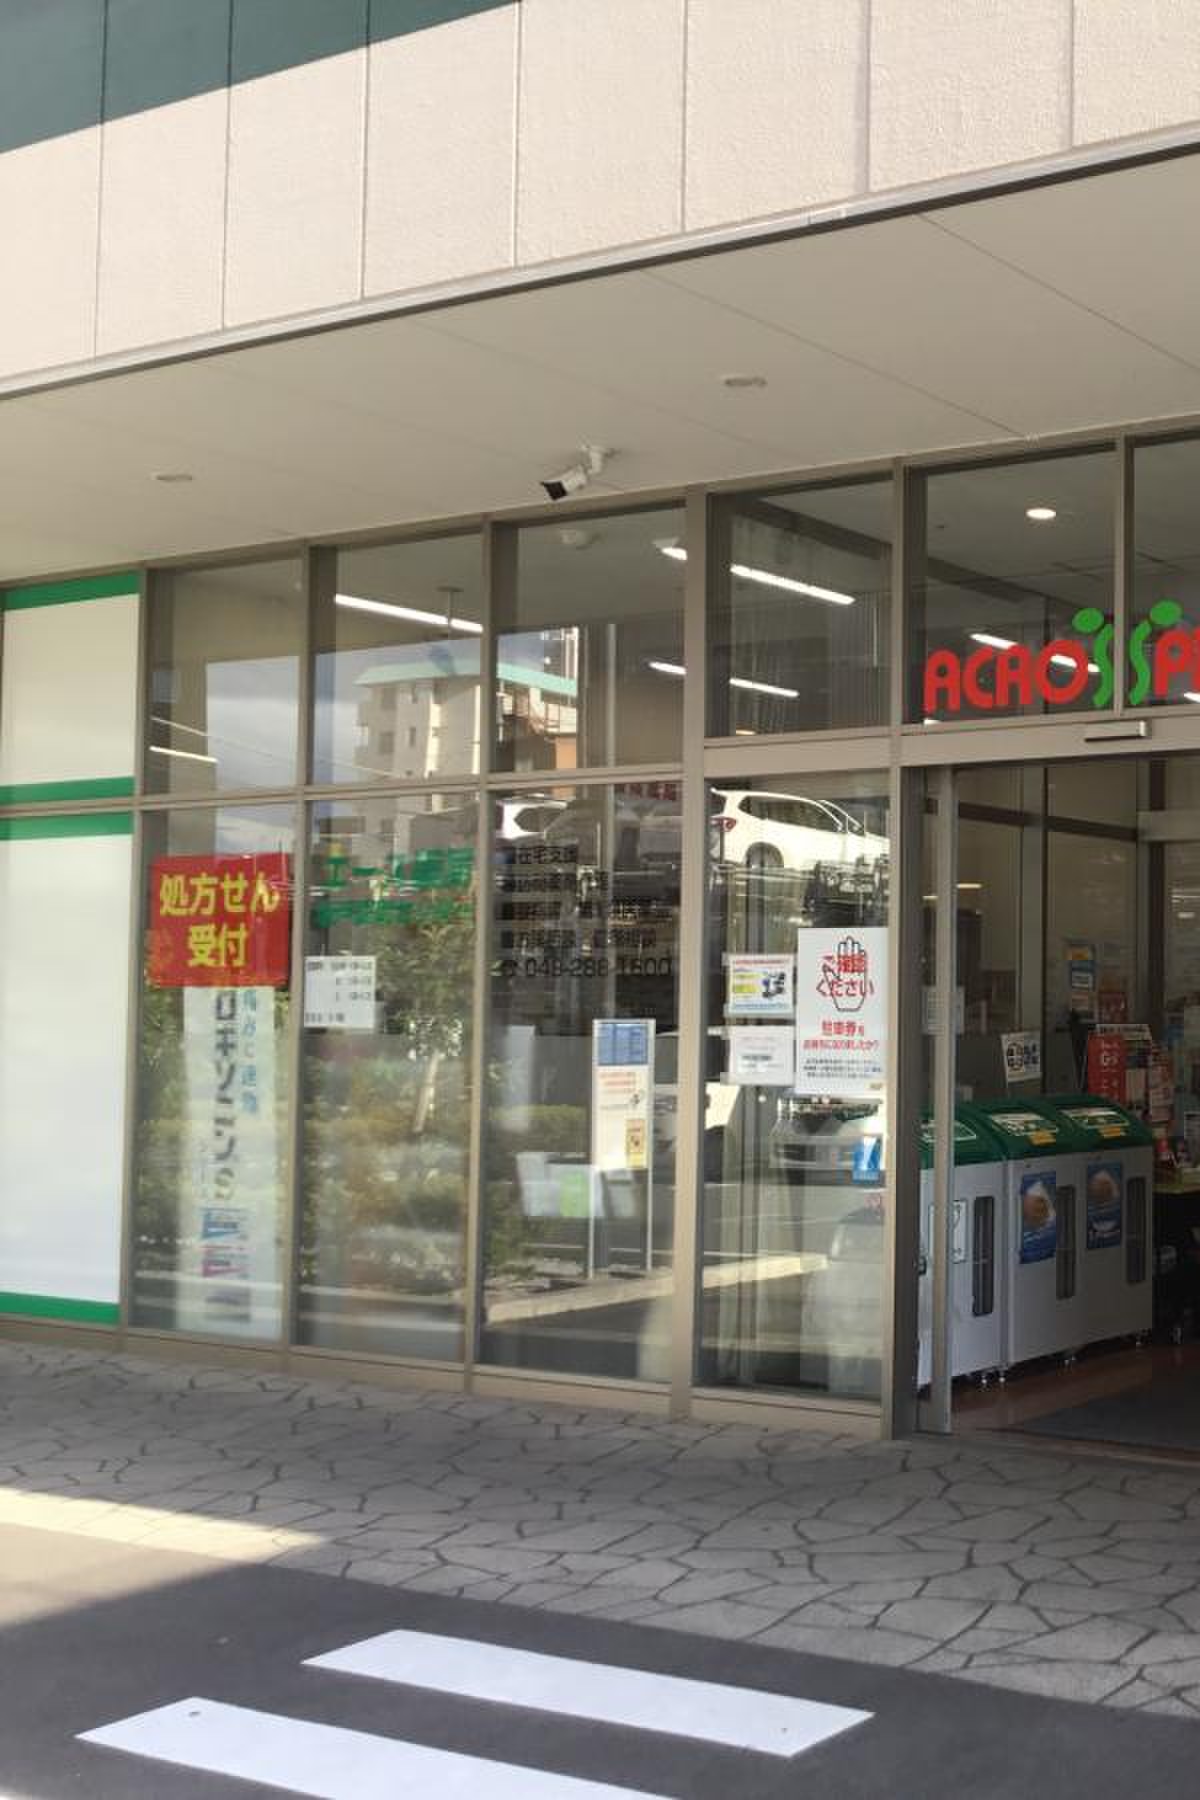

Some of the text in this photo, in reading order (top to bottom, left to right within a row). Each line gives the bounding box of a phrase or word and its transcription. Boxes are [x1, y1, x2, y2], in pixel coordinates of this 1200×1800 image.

[924, 600, 1182, 714] ACROSS
[160, 872, 280, 917] 処方せん
[187, 922, 247, 968] 受付
[816, 978, 875, 998] ください
